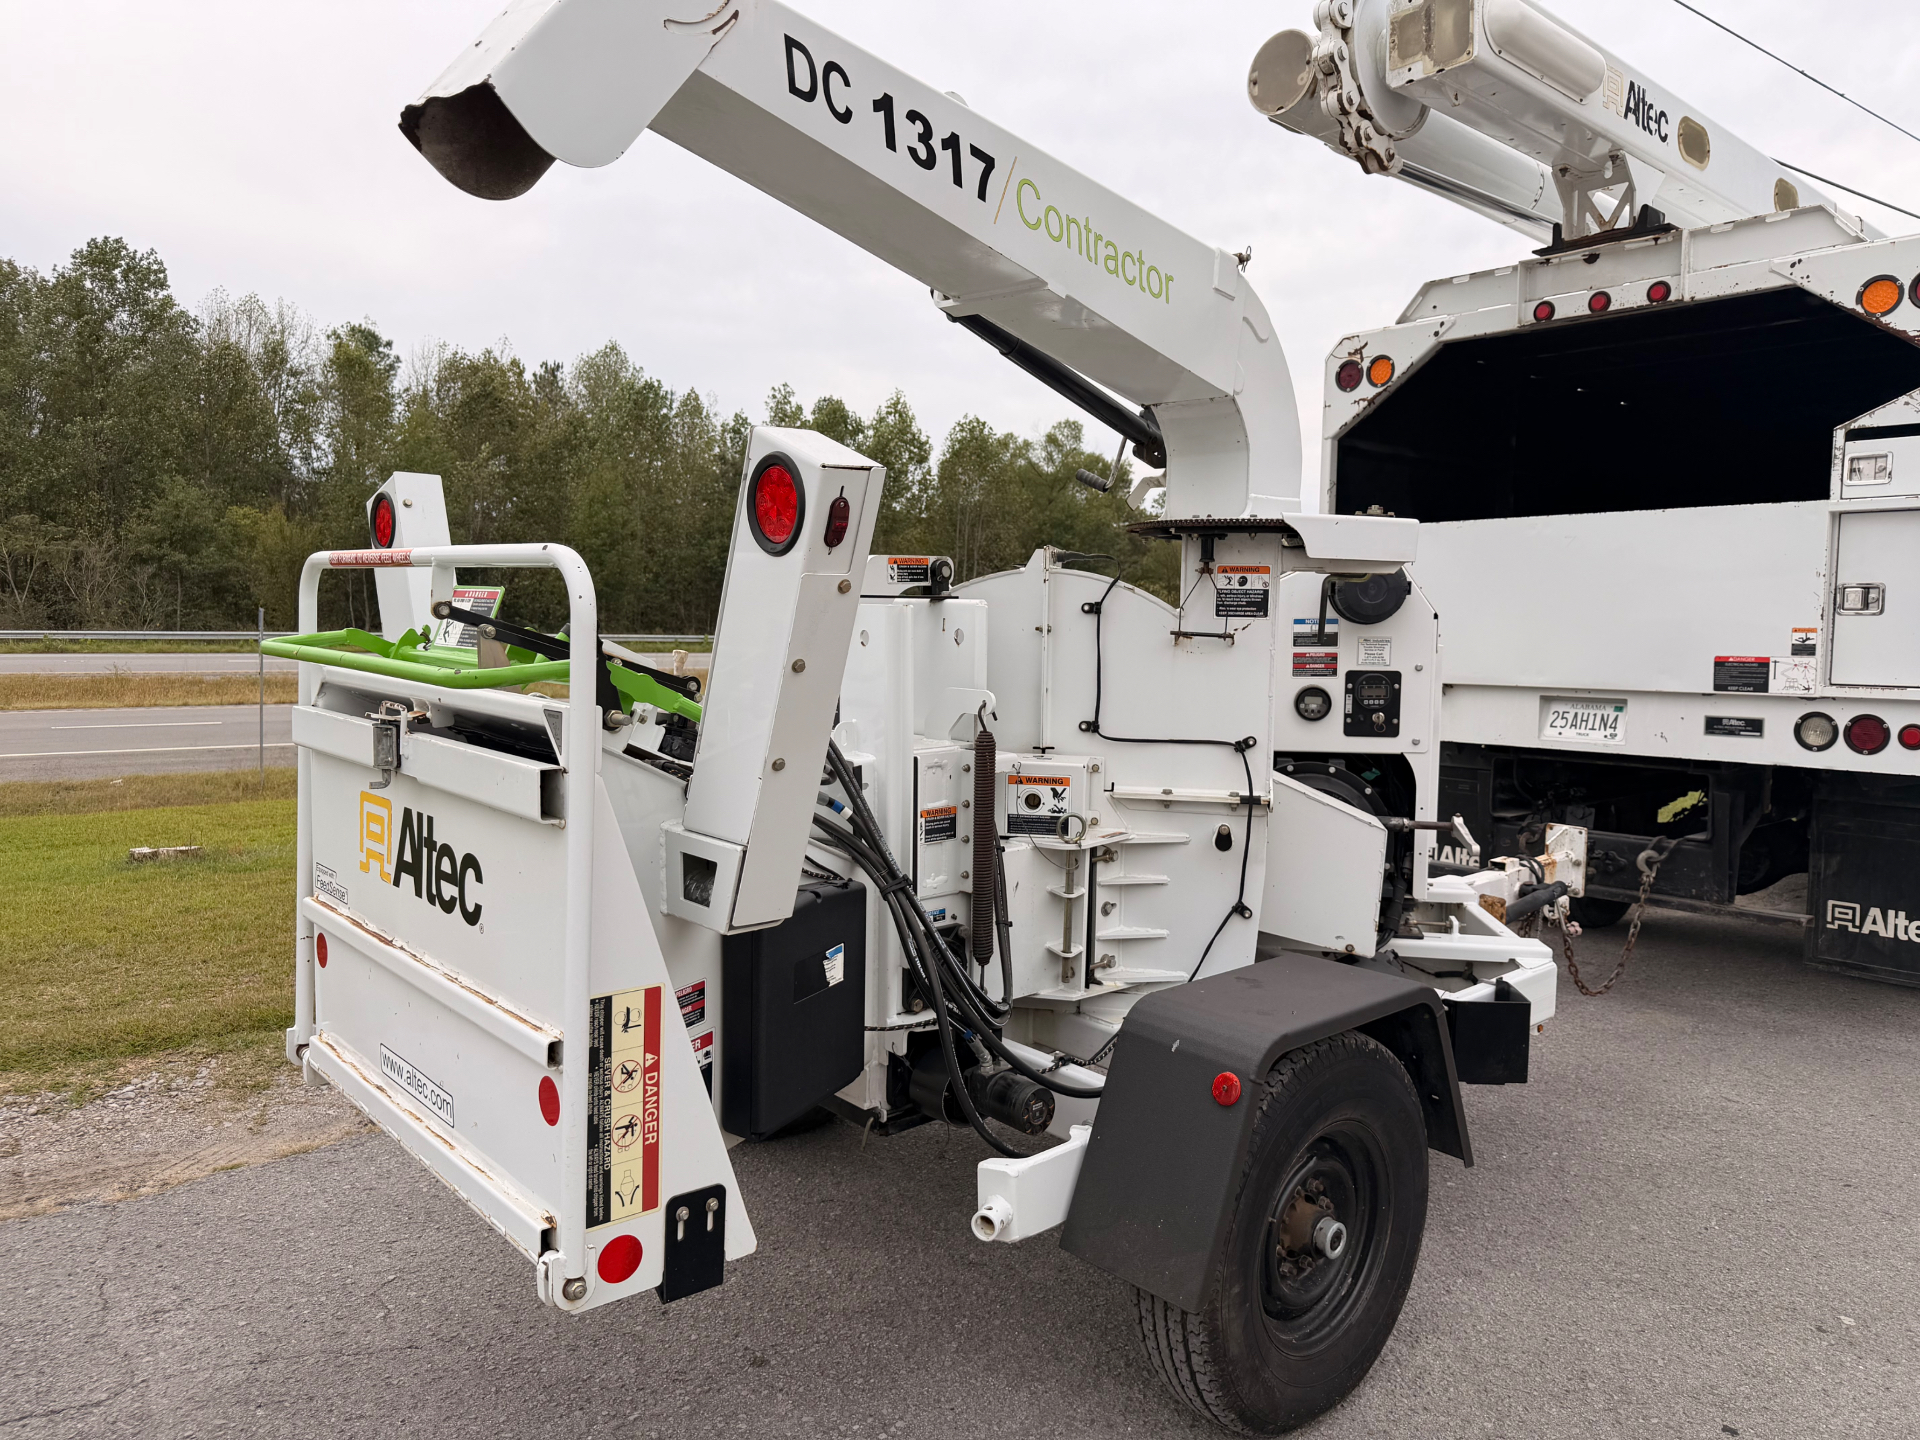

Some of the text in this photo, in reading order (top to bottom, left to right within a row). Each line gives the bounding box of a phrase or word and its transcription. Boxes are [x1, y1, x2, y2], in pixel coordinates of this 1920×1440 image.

[783, 33, 996, 203] DC 1317
[1624, 80, 1669, 144] Altec
[1016, 177, 1175, 304] Contractor
[1549, 710, 1619, 732] 25AH1N4
[926, 808, 952, 817] WARNING
[393, 807, 484, 927] Altec
[1439, 845, 1480, 867] Alte
[1861, 907, 1920, 943] Alte
[681, 1005, 692, 1014] NGER
[381, 1052, 452, 1119] www.altec.com
[644, 1072, 659, 1146] DANGER
